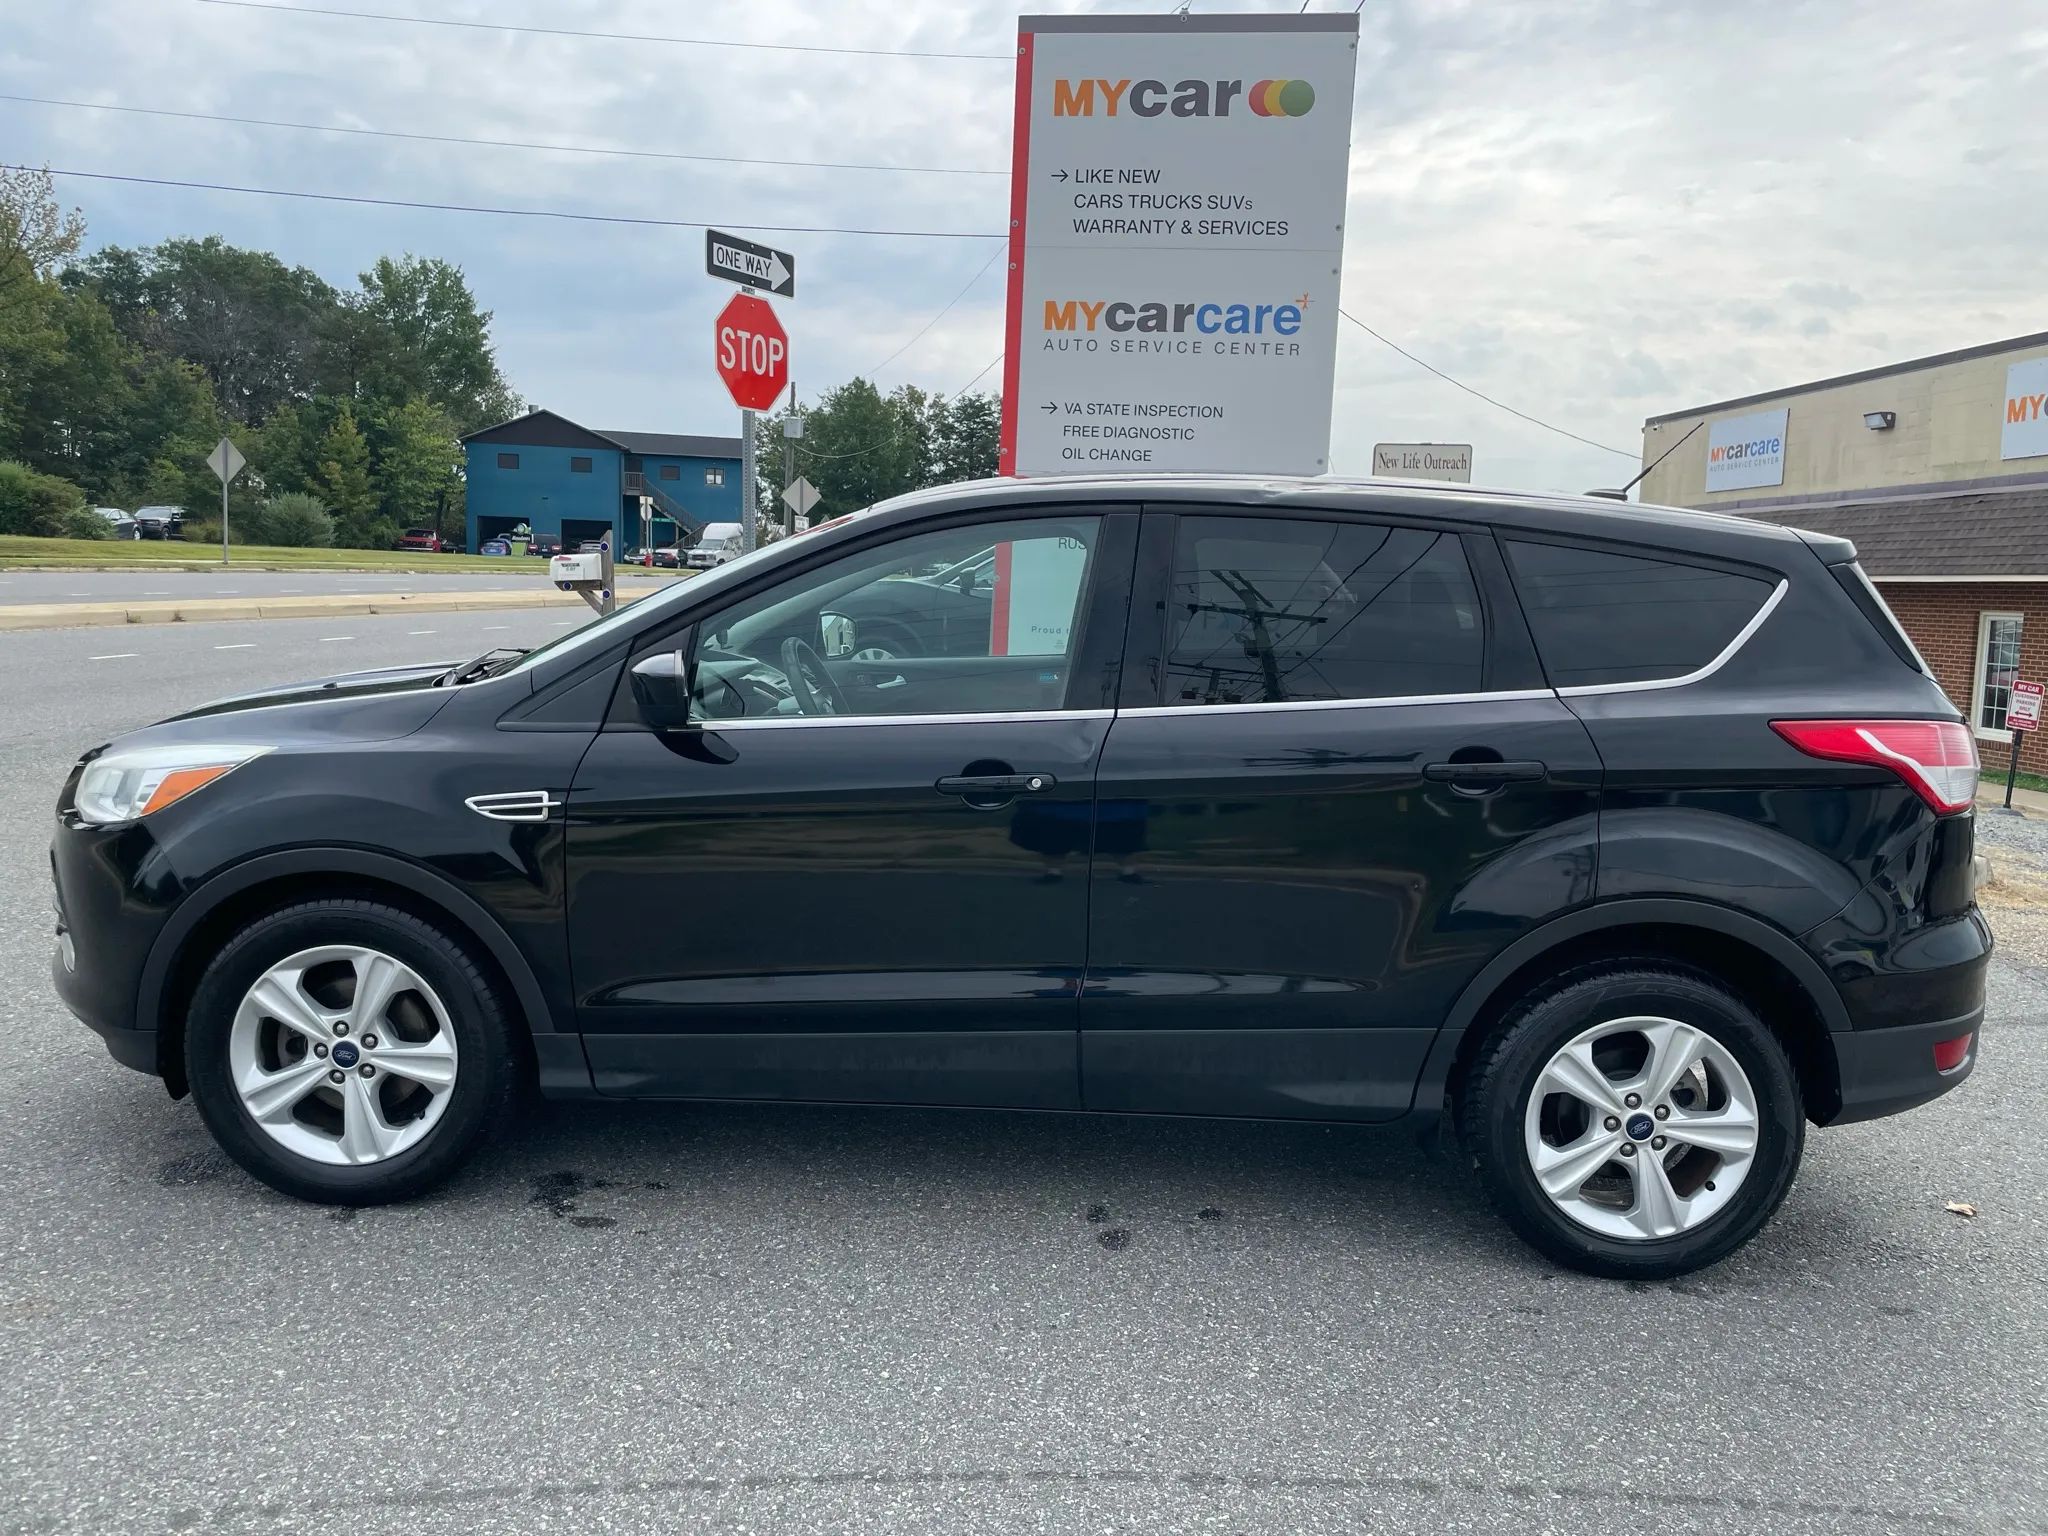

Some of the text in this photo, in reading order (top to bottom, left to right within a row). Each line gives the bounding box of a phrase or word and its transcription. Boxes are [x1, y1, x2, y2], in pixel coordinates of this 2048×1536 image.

[1053, 79, 1242, 118] MYcar
[1075, 169, 1161, 184] LIKE NEW
[1074, 194, 1253, 210] CARS TRUCKS SUVs
[1073, 219, 1289, 236] WARRANTY & SERVICES
[716, 246, 772, 278] ONE WAY
[720, 326, 784, 378] STOP
[1043, 338, 1300, 356] AUTO SERVICE CENTER
[1064, 403, 1223, 418] VA STATE INSPECTION
[2007, 393, 2048, 424] MY
[1063, 425, 1195, 440] FREE DIAGNOSTIC
[1062, 447, 1152, 462] OIL CHANGE
[1379, 452, 1467, 470] New Life Outreach
[1710, 456, 1779, 472] AUTO SERVICE CENTER
[1031, 625, 1061, 634] Proud
[2017, 683, 2040, 693] MY CAR
